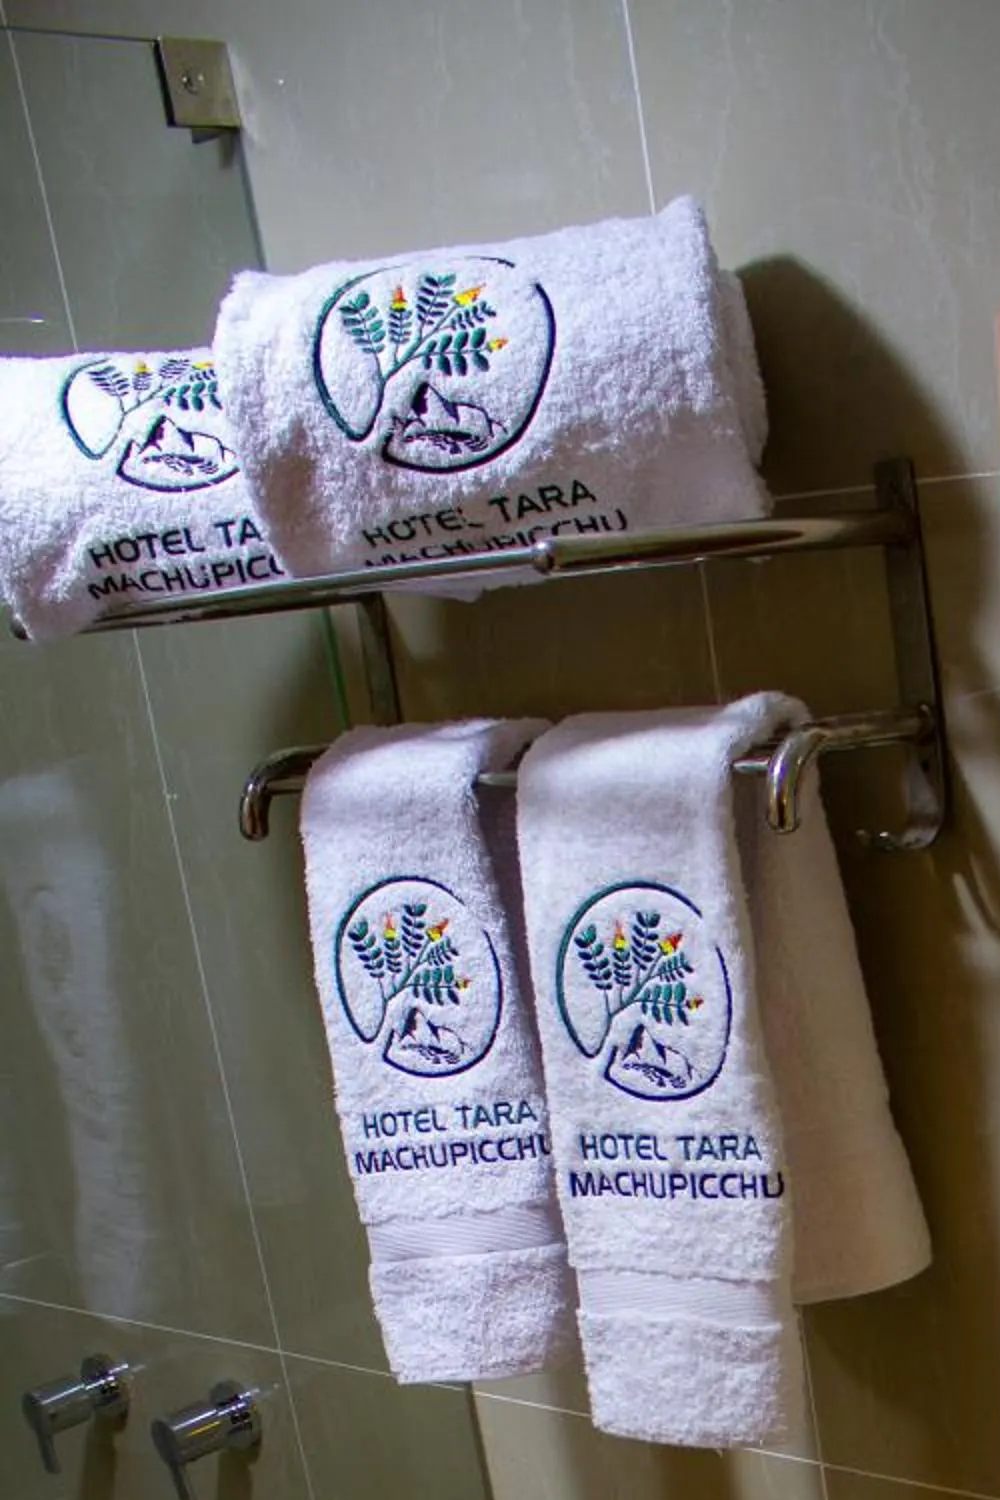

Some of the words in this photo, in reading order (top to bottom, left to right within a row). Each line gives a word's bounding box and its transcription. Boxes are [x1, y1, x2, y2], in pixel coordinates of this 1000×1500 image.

[361, 506, 484, 548] HOTEL
[488, 479, 598, 523] TARA
[88, 527, 206, 569] HOTEL
[214, 516, 264, 548] TA
[363, 1107, 448, 1139] HOTEL
[455, 1100, 539, 1130] TARA
[579, 1134, 668, 1160] HOTEL
[675, 1134, 763, 1161] TARA
[569, 1170, 786, 1199] MACHUPICCHU
